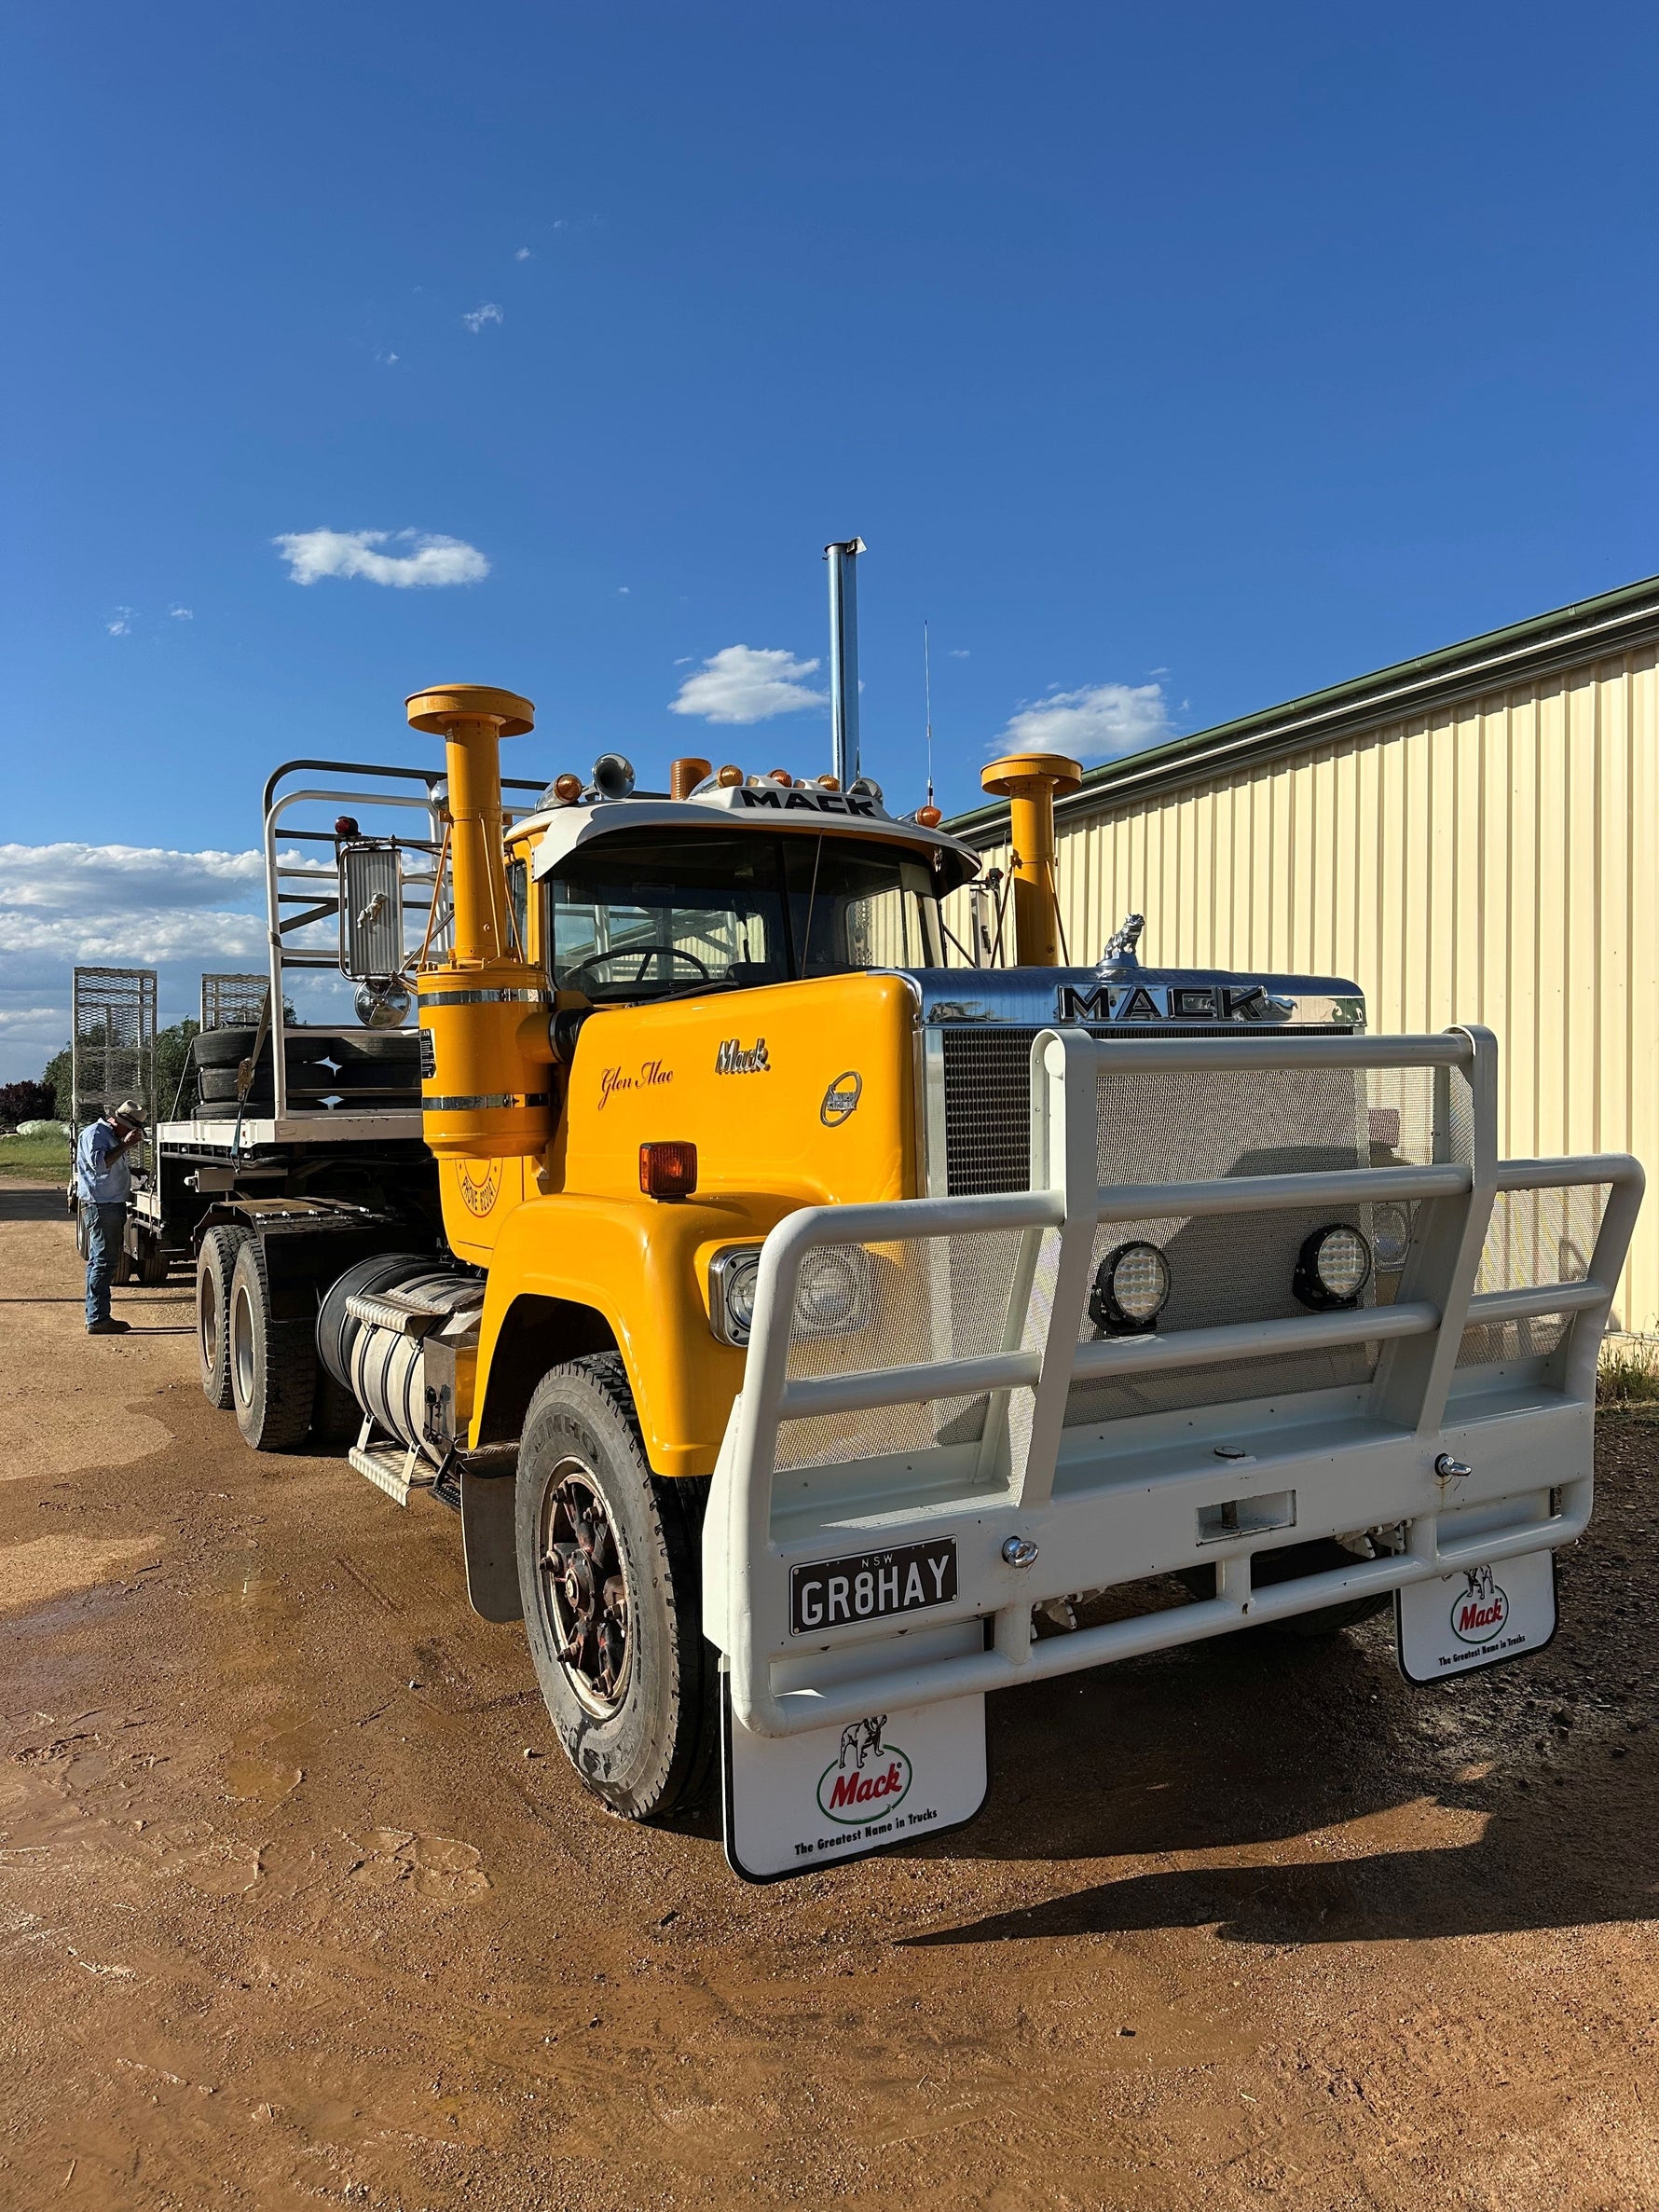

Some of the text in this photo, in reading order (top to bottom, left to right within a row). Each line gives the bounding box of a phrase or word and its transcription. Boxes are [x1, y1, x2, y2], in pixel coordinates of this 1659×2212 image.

[740, 790, 877, 817] MACK
[1057, 984, 1268, 1023] MACK
[715, 1037, 771, 1075] Mack
[597, 1059, 674, 1111] Glen Mac
[861, 1553, 893, 1569] NSW
[802, 1555, 950, 1626] GR8HAY
[1459, 1598, 1504, 1632] Mack
[1438, 1634, 1526, 1666] The Greatest Name in Trucks
[829, 1763, 902, 1809] Mack
[794, 1808, 938, 1856] The Greatest Name in Trucks
